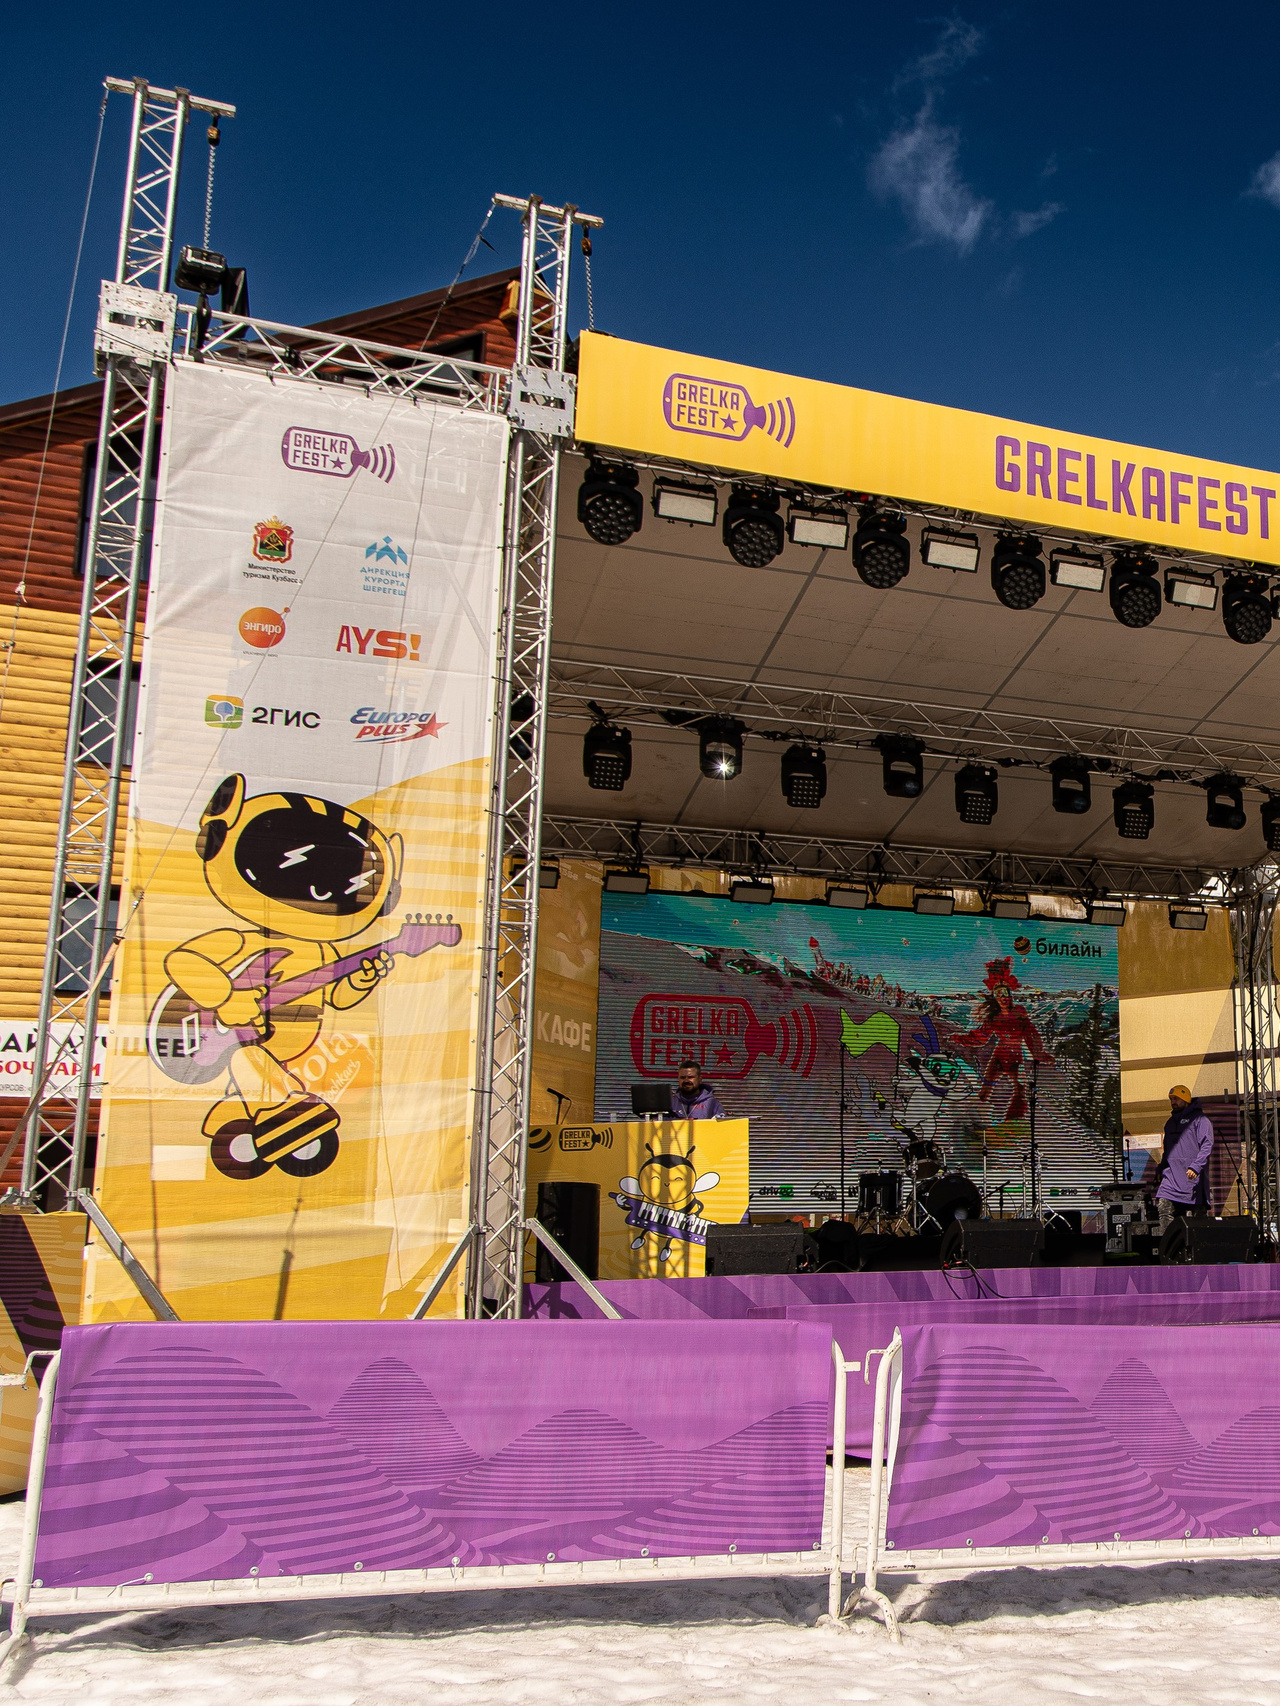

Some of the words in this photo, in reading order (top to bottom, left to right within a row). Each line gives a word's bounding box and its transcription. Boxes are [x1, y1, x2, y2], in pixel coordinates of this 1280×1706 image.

[677, 382, 740, 411] GRELKA
[676, 404, 719, 428] FEST
[293, 433, 348, 455] GRELKA
[293, 449, 329, 468] FEST
[995, 435, 1277, 540] GRELKAFEST
[242, 571, 271, 580] туризма
[248, 563, 296, 575] Министерство
[360, 566, 410, 579] ДИРЕКЦИЯ
[362, 584, 407, 597] ШЕРЕГЕШ
[364, 576, 406, 588] КУРОРТА
[243, 621, 282, 635] энгиро
[336, 625, 422, 662] AYS!
[251, 706, 321, 729] 2ГИС
[1035, 938, 1102, 958] билайн
[651, 1005, 739, 1035] GRELKA
[537, 1010, 592, 1053] КАФЕ
[650, 1038, 711, 1066] FEST
[564, 1131, 590, 1139] GRELKA
[564, 1140, 582, 1148] FEST
